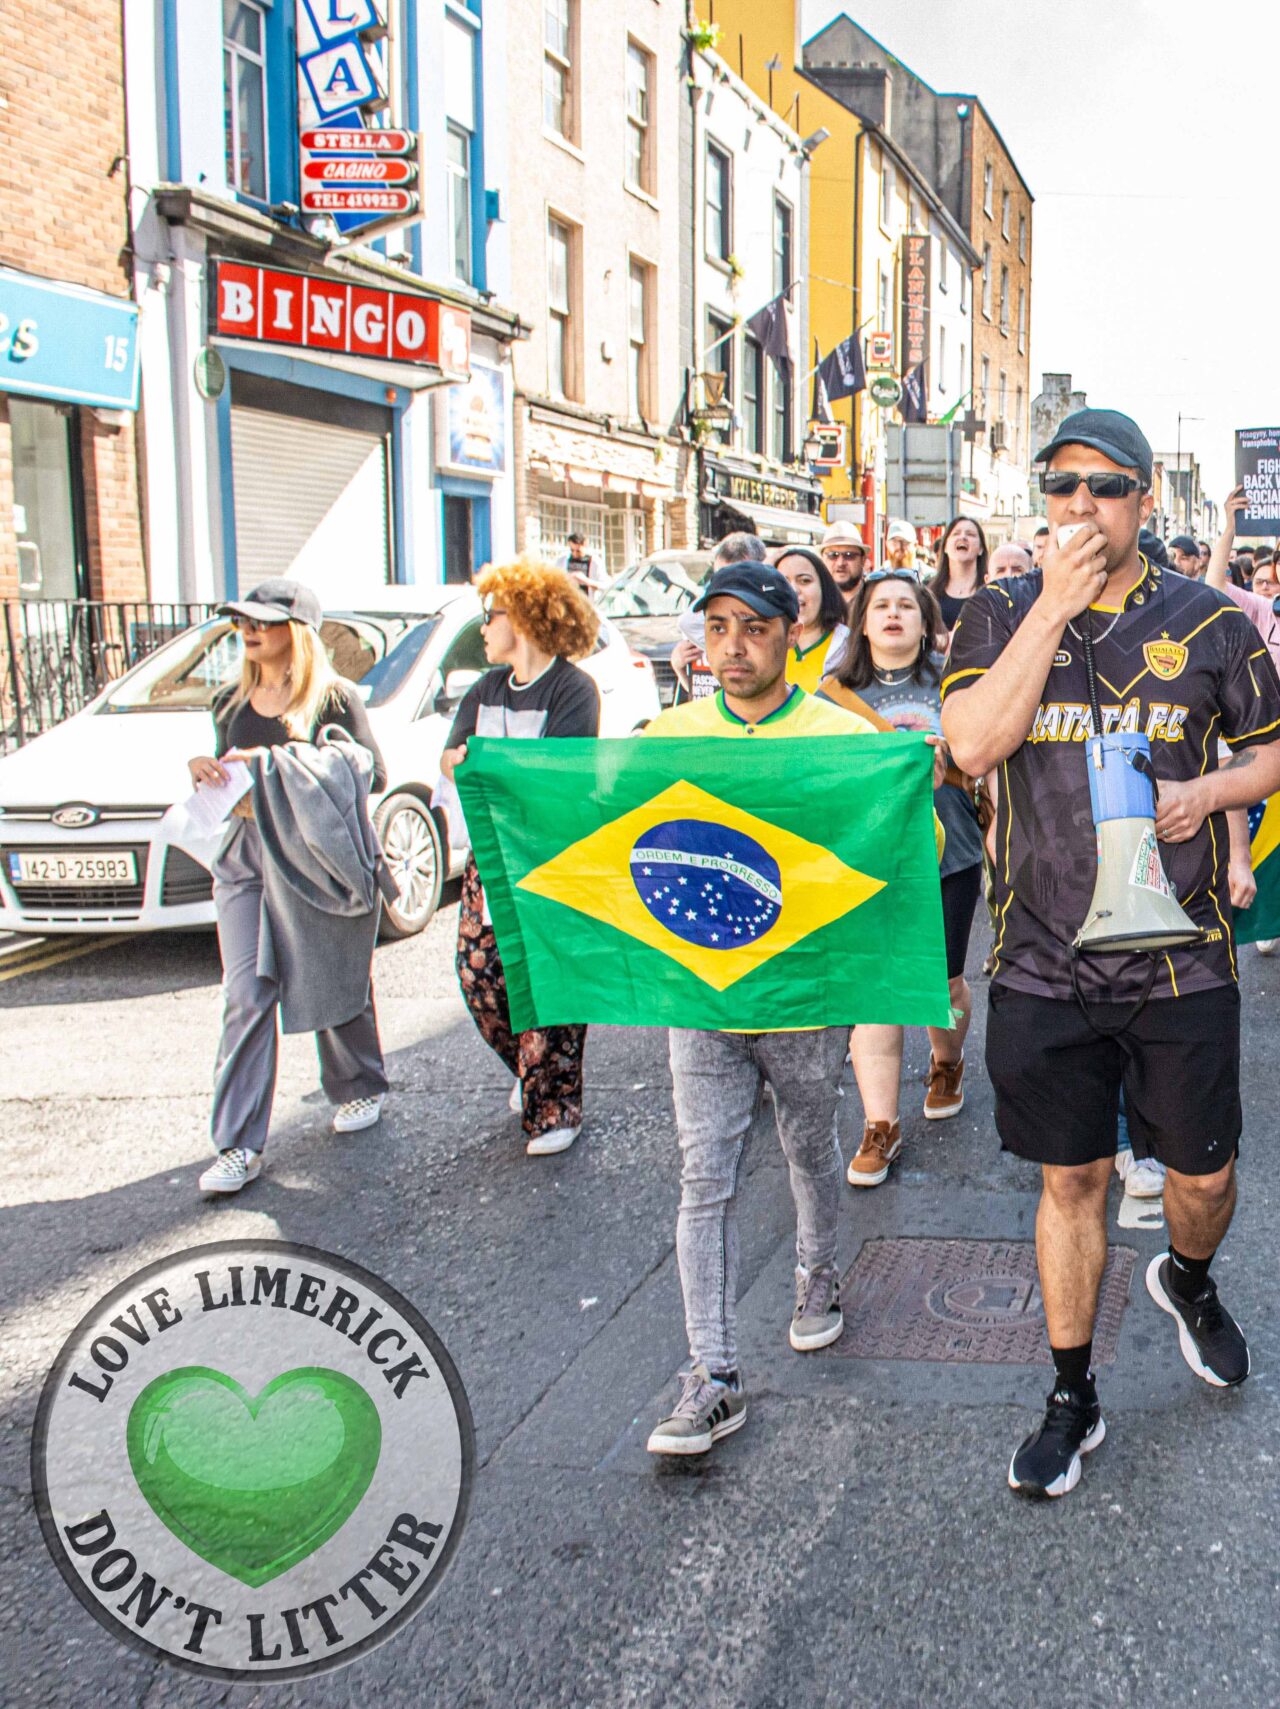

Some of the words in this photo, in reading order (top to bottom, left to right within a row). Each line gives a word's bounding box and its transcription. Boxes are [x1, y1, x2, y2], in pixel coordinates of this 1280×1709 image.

[313, 133, 391, 148] STELLA
[322, 163, 387, 178] CASINO
[221, 280, 427, 351] BINGO
[104, 335, 128, 372] 15
[1244, 474, 1273, 489] BACK
[25, 860, 128, 879] 142-D-25983
[636, 850, 683, 862] ORDEM
[701, 857, 778, 899] PROGRESSO
